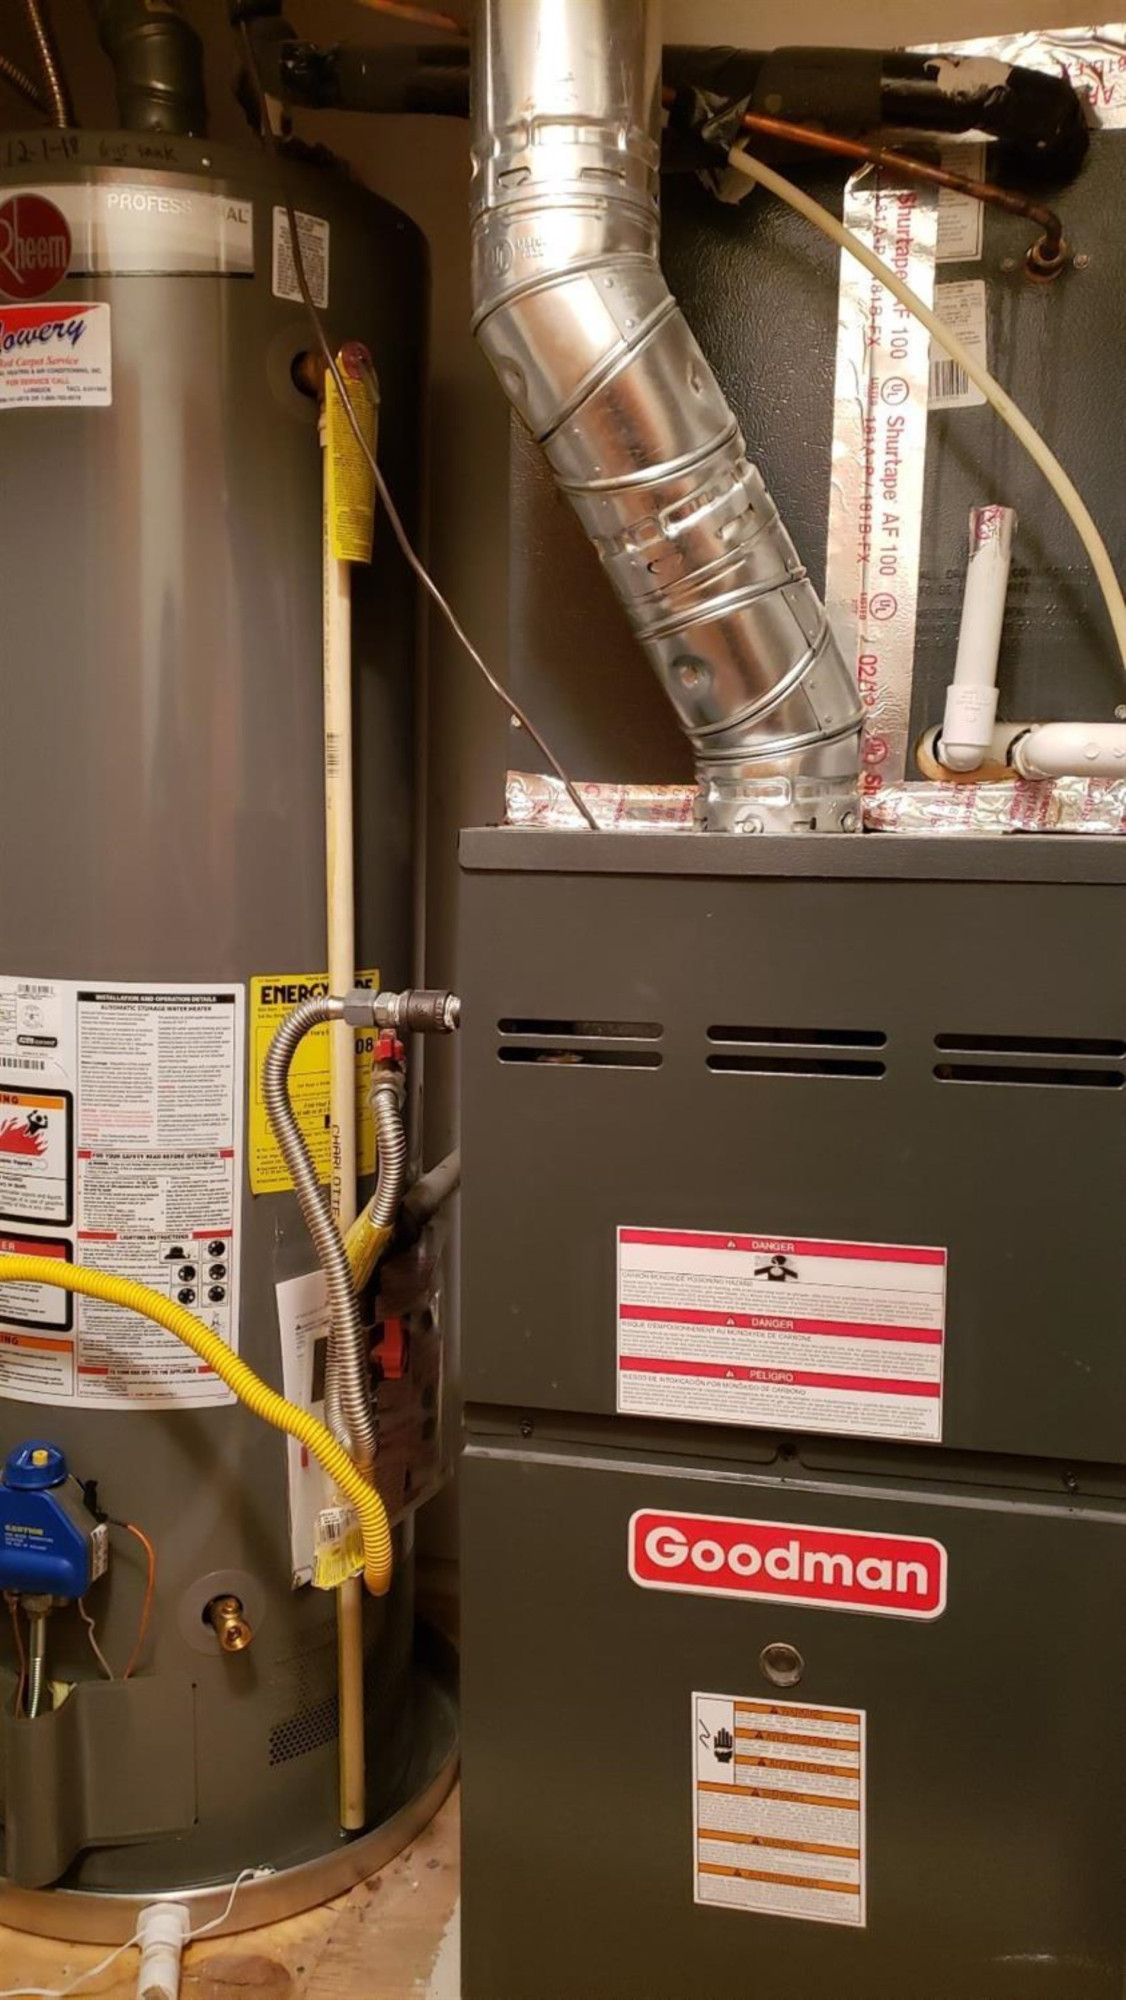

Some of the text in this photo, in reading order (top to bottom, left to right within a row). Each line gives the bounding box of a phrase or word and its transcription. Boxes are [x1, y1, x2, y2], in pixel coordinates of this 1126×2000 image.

[107, 192, 248, 224] PROFESSAL
[893, 192, 918, 279] Shurtape
[889, 328, 909, 360] 100
[879, 415, 905, 576] Shurtape AF 100
[331, 1124, 341, 1218] CHARLOTTE
[752, 1240, 795, 1252] DANGER
[751, 1318, 794, 1330] DANGER
[749, 1370, 794, 1382] PELIGRO
[645, 1526, 928, 1595] Goodman
